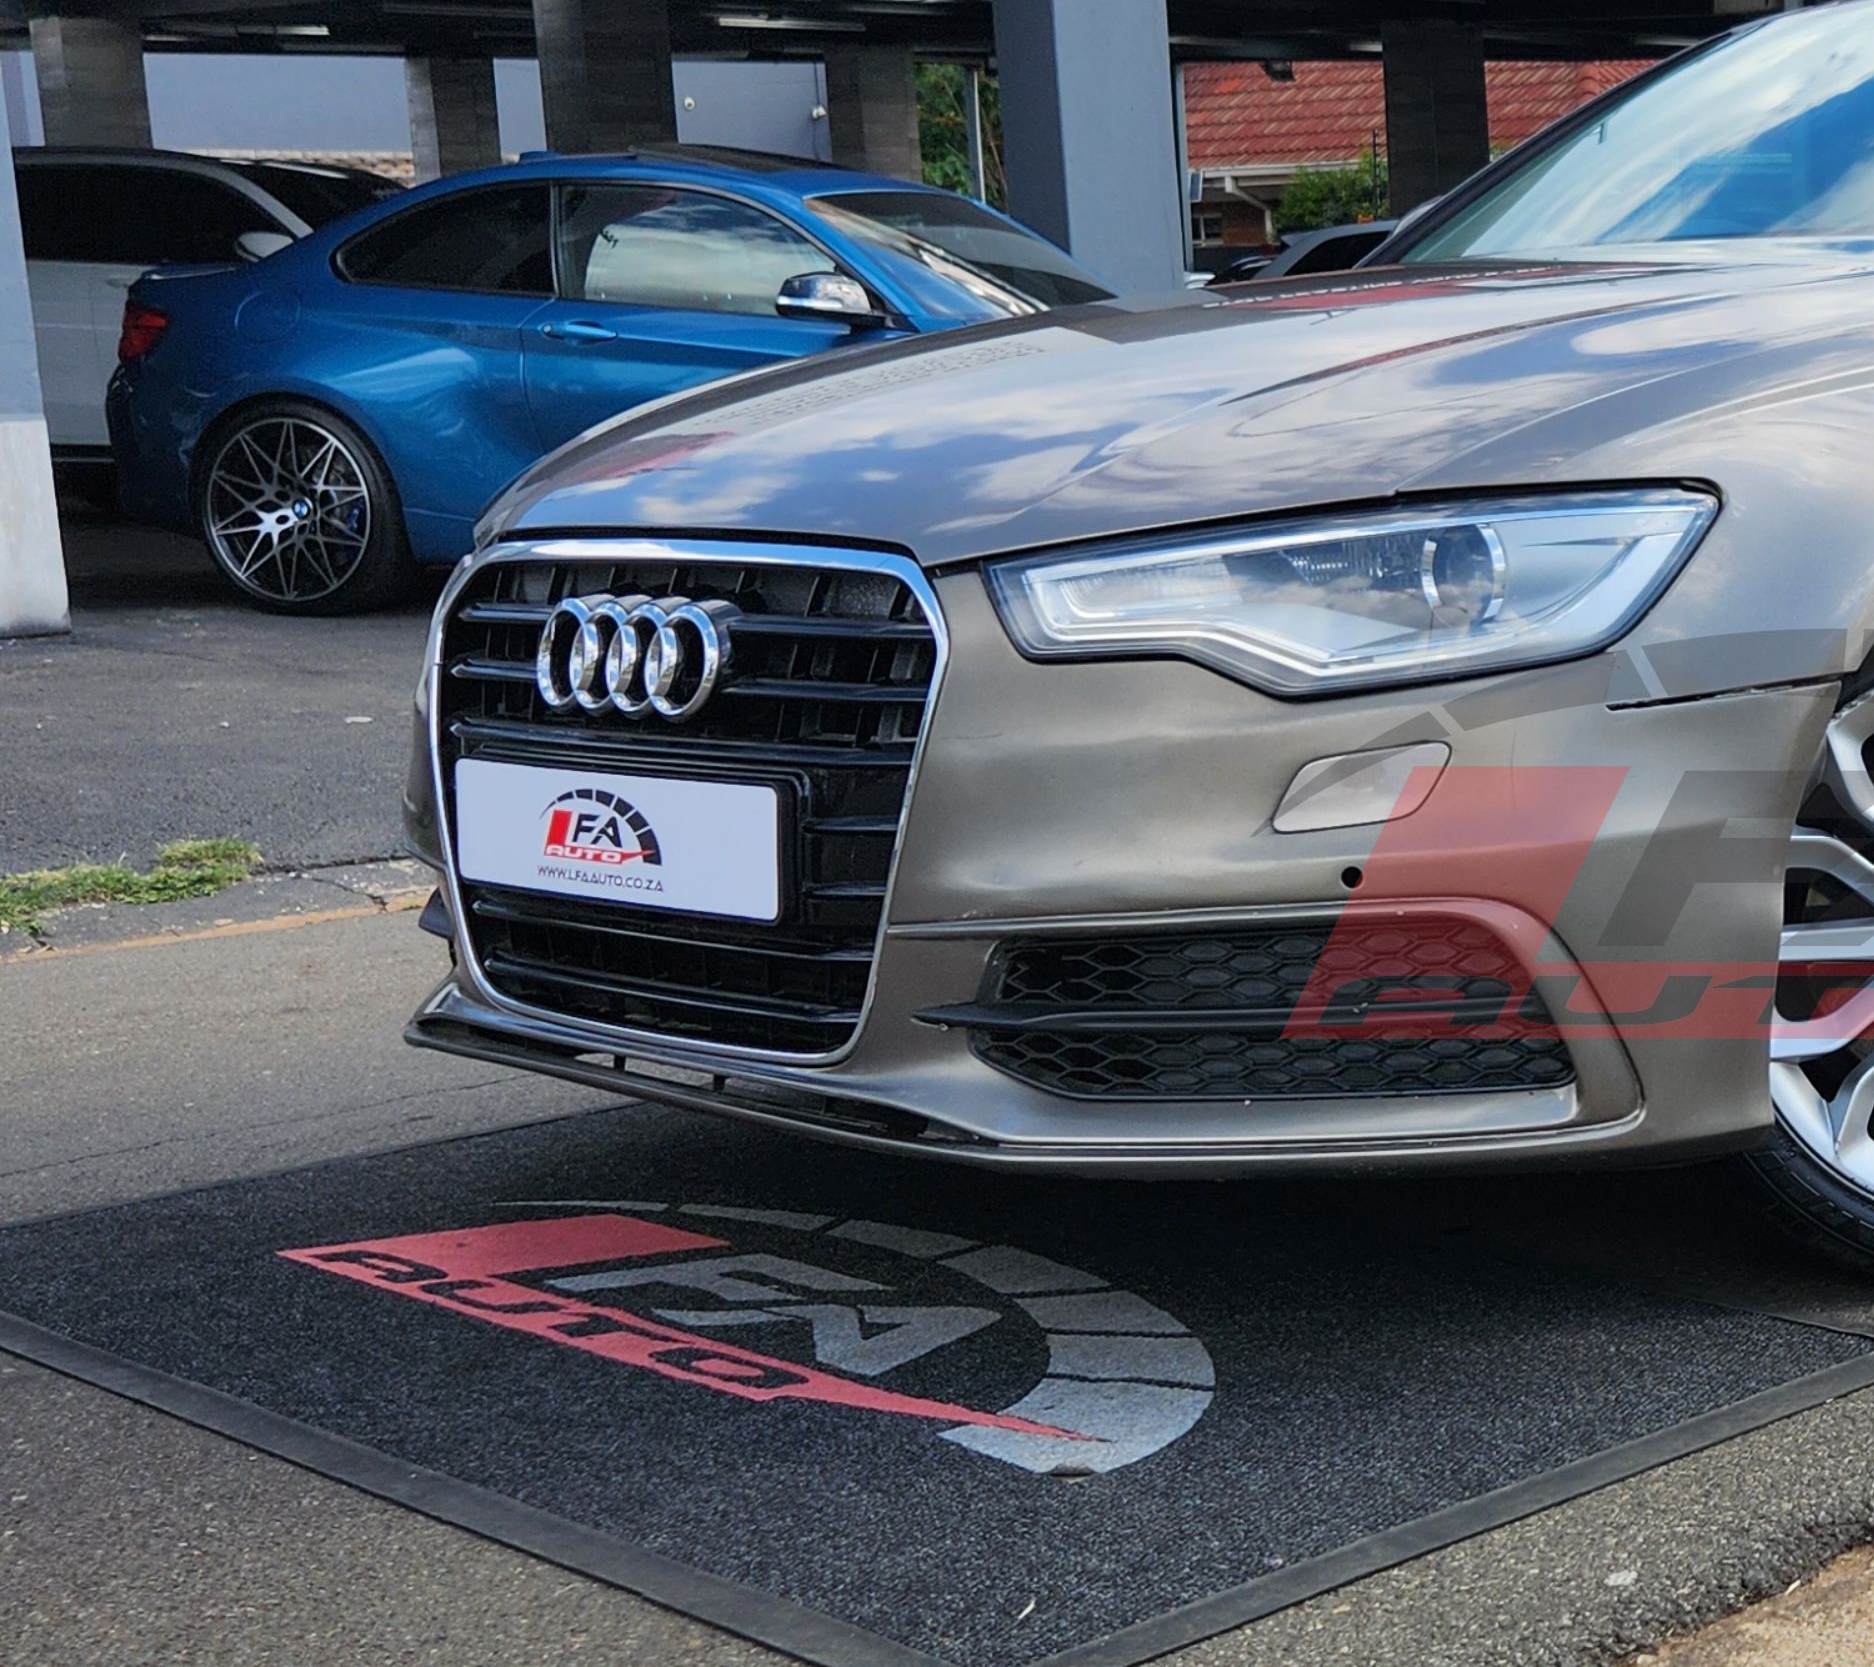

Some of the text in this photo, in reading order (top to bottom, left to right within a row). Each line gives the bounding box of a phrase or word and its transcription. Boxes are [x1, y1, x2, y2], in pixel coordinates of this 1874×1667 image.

[545, 844, 622, 864] AUTO
[537, 865, 664, 892] WWW.LFAAUTO.CO.ZA
[322, 1250, 811, 1389] AUTO
